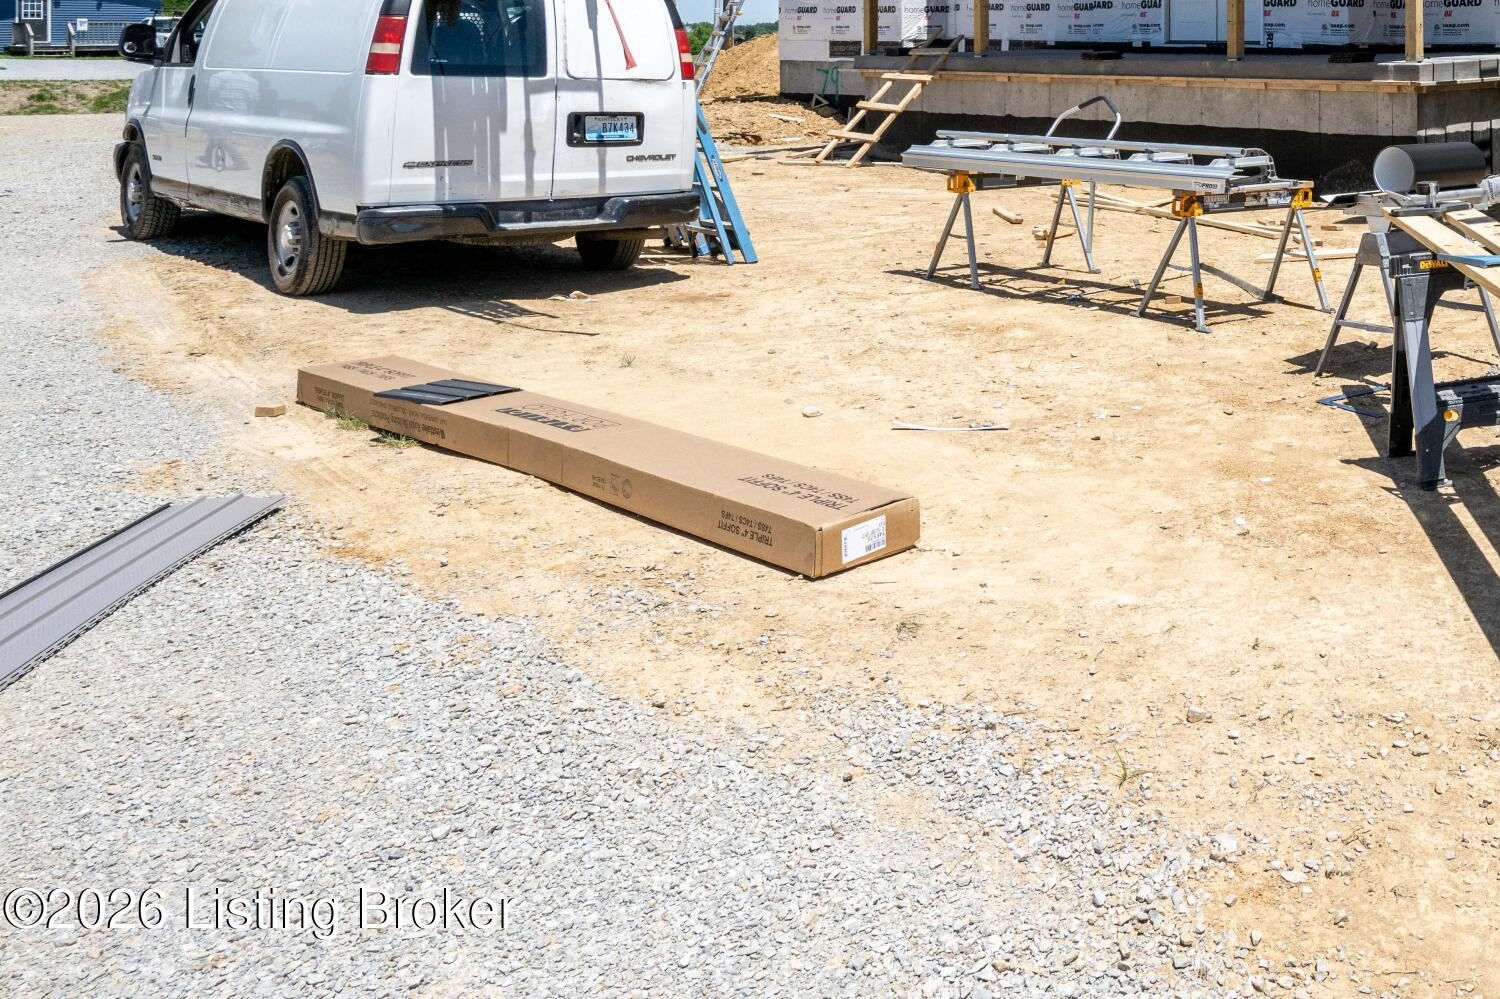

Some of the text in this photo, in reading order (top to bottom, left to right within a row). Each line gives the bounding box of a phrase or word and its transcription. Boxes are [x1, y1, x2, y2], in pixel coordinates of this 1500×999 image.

[1011, 3, 1050, 12] homeGUARD
[1331, 10, 1341, 18] OX
[1443, 10, 1453, 18] OX
[602, 122, 635, 133] B7K434
[626, 153, 677, 163] CHEVROLET
[736, 476, 787, 493] SOFFIT
[793, 483, 825, 494] T4CS
[797, 493, 848, 510] TRIPLE
[738, 514, 753, 528] T4CS
[717, 519, 740, 536] SOFFIT
[757, 521, 772, 534] T4SS
[749, 530, 773, 547] TRIPLE
